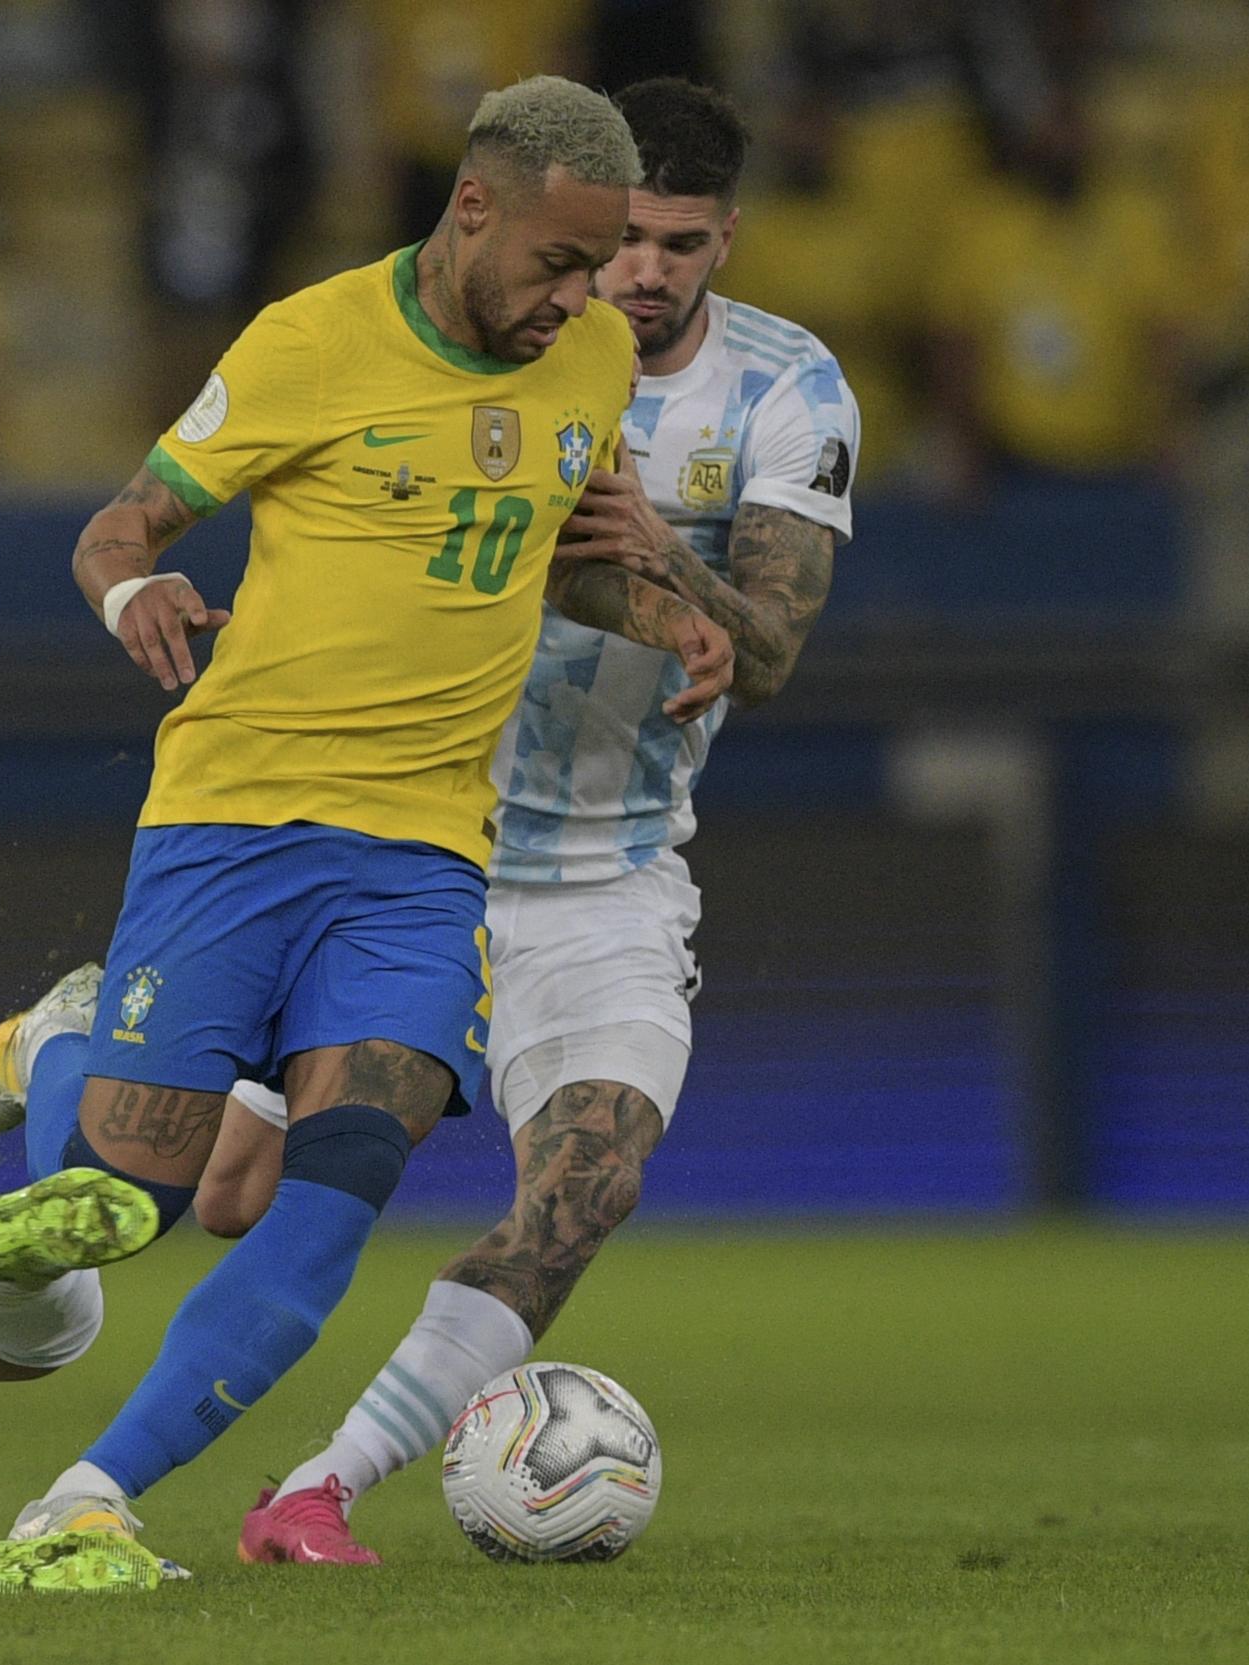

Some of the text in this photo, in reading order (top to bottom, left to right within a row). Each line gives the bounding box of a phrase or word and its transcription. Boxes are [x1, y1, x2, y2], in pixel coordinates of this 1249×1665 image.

[690, 462, 724, 494] AFA
[425, 488, 535, 596] 10
[112, 1028, 146, 1045] BRASIL
